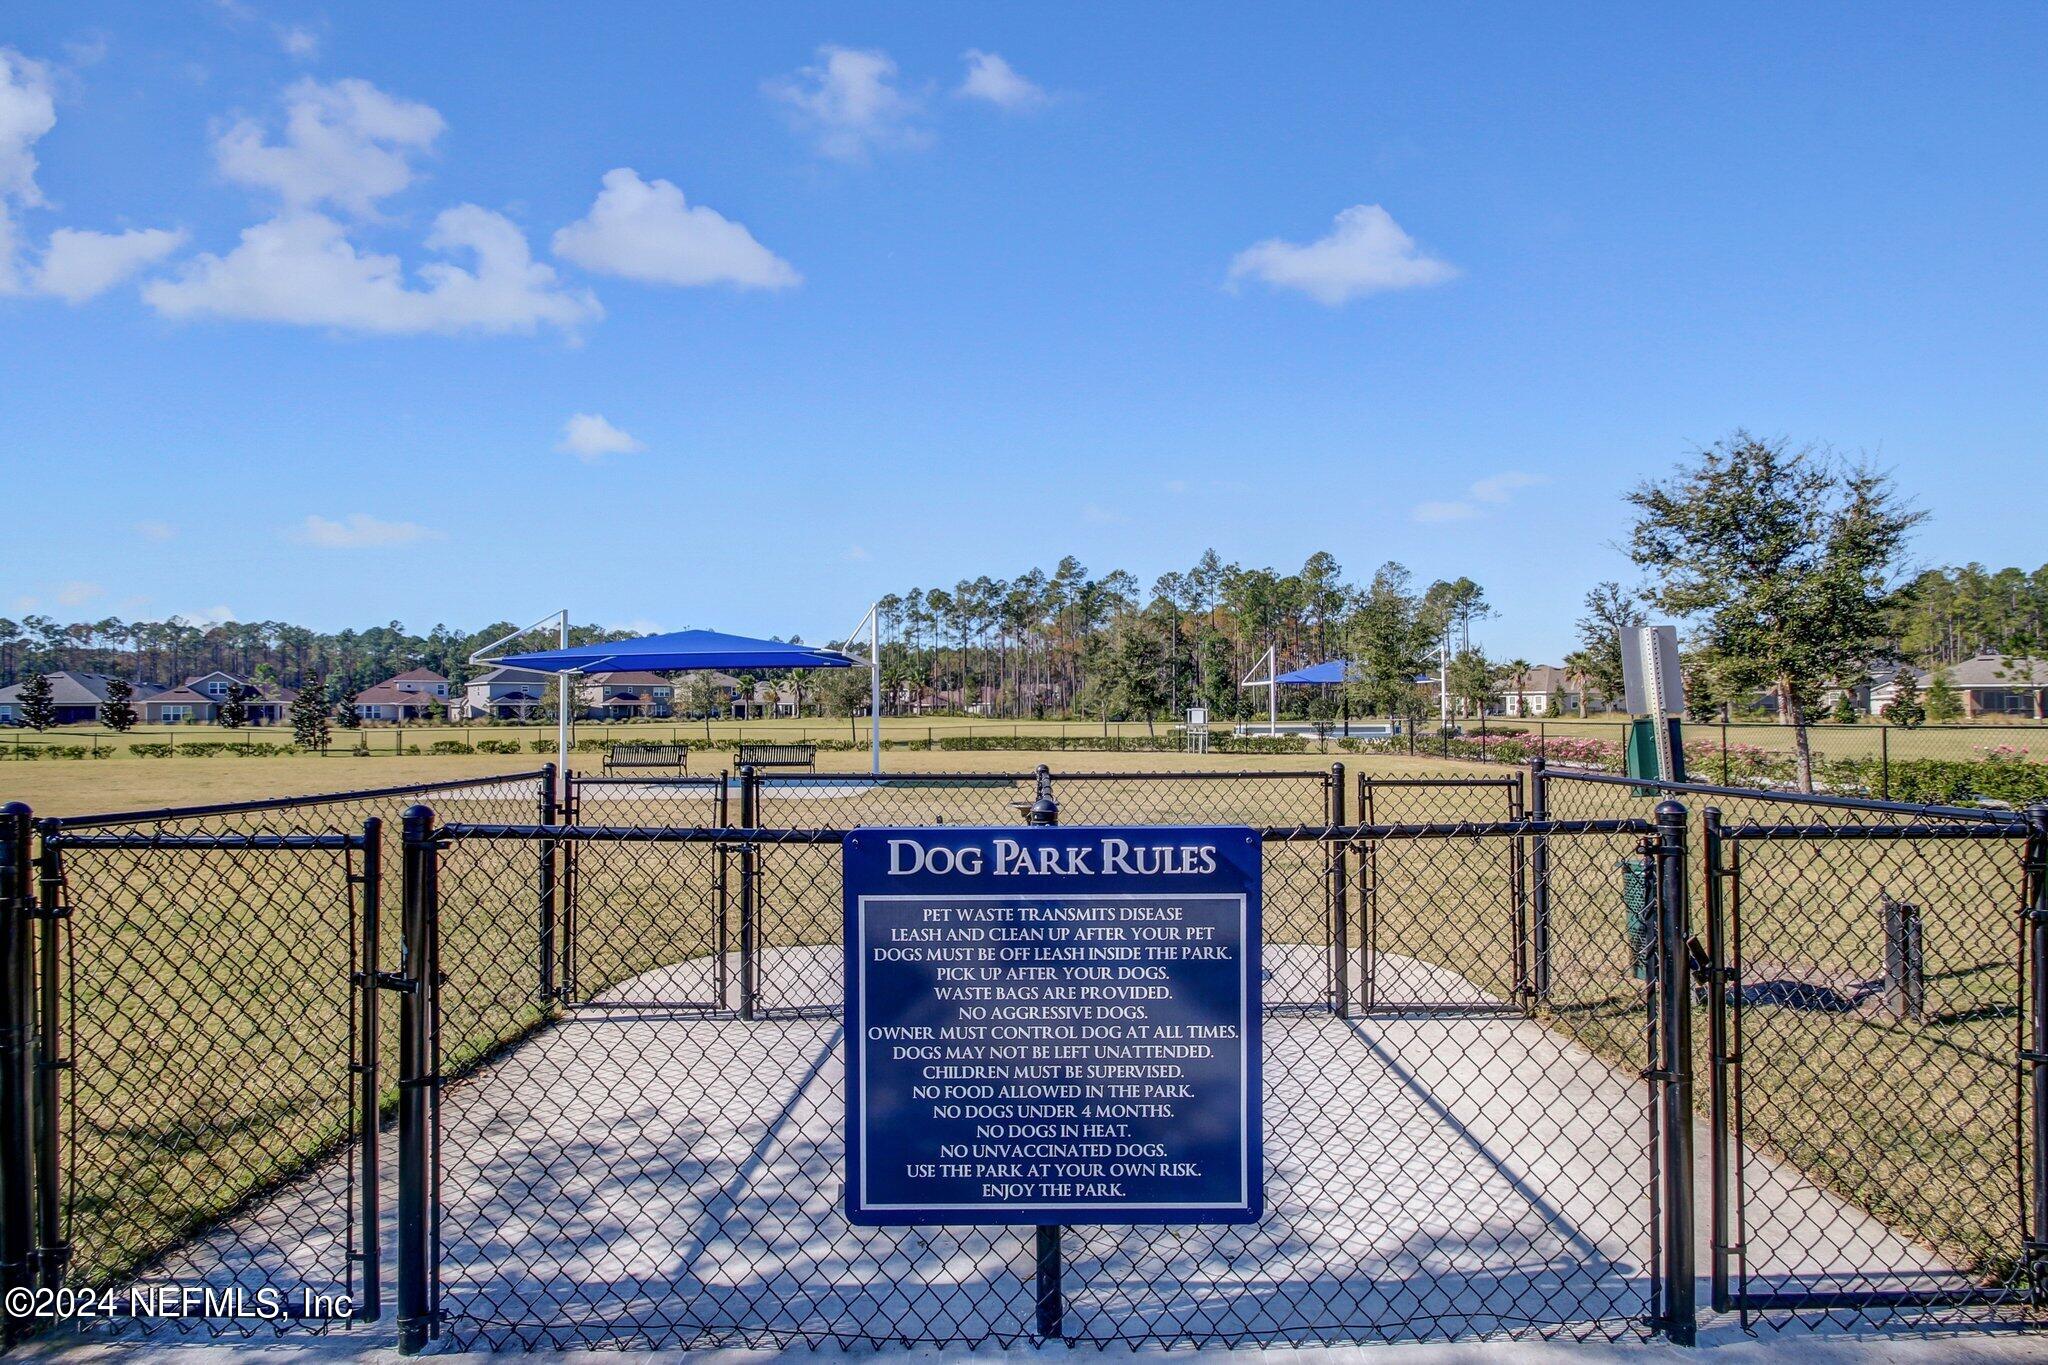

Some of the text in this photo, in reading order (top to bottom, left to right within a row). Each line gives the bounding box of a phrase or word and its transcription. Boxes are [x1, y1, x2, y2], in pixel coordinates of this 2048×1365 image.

[922, 907, 1183, 922] PET WASTE TRANSMITS DISEASE
[890, 926, 1216, 942] LEASH AND CLEAN UP AFTER YOUR PET
[873, 946, 1232, 962] DOGS MUST BE OFF LEASH INSIDE THE PARK.
[936, 966, 1170, 981] PICK UP AFTER YOUR DOGS.
[933, 985, 1173, 1001] WASTE BAGS ARE PROVIDED.
[958, 1005, 1149, 1021] NO AGGRESSIVE DOGS.
[868, 1024, 1239, 1040] OWNER MUST CONTROL DOG AT ALL TIMES.
[892, 1044, 1215, 1060] DOGS MAY NOT BE LEFT UNATTENDED.
[922, 1064, 1185, 1080] CHILDREN MUST BE SUPERVISED.
[912, 1084, 1195, 1099] NO FOOD ALLOWED IN THE PARK.
[933, 1104, 1175, 1119] NO DOGS UNDER 4 MONTHS.
[976, 1124, 1131, 1139] NO DOGS IN HEAT.
[940, 1143, 1168, 1158] NO UNVACCINATED DOGS.
[906, 1163, 1202, 1178] USE THE PARK AT YOUR OWN RISK.
[982, 1183, 1126, 1200] ENJOY THE PARK.
